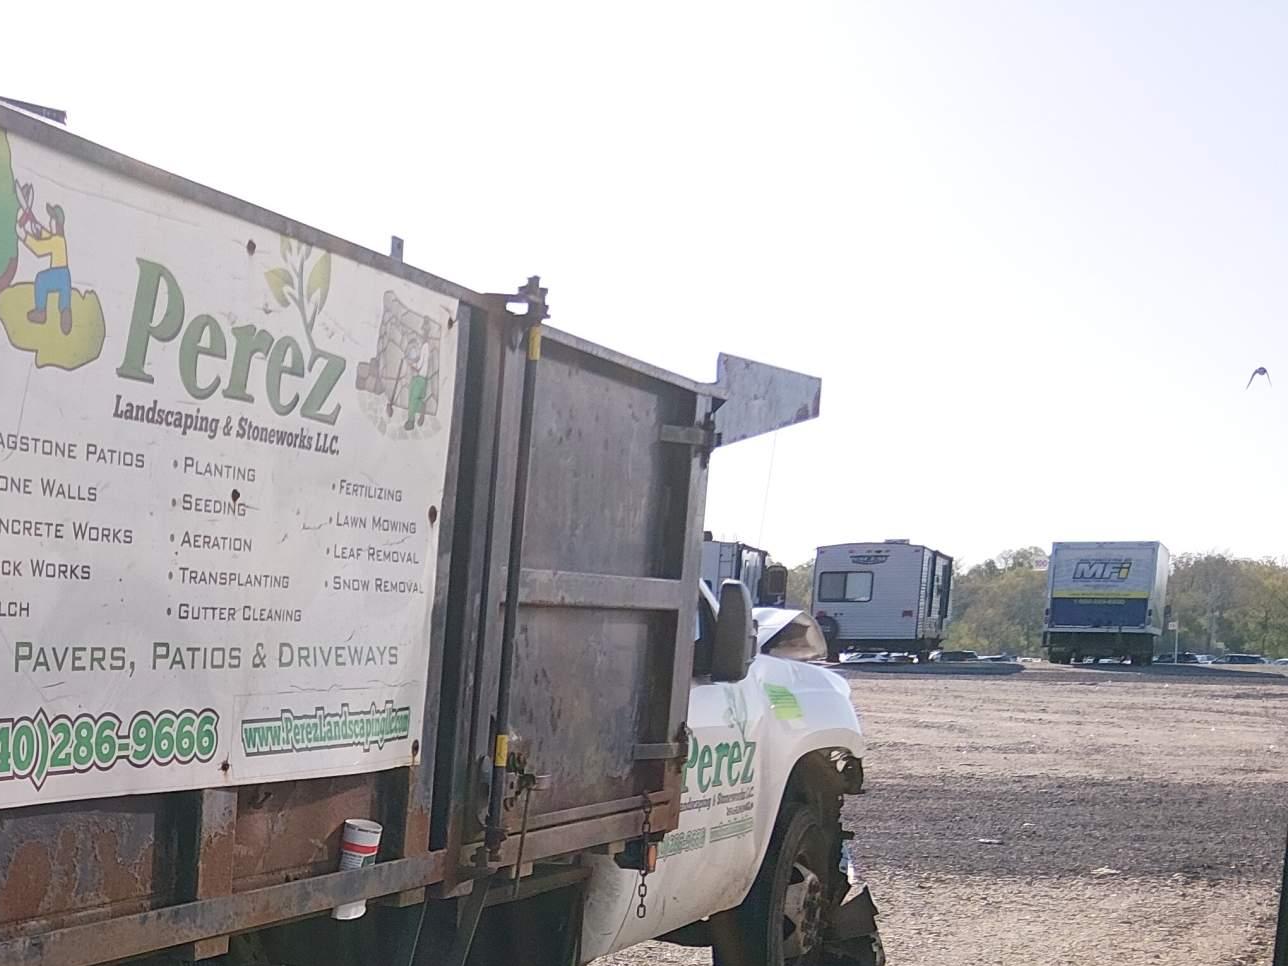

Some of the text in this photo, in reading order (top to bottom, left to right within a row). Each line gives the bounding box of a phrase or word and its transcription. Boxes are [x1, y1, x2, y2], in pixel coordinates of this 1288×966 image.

[115, 257, 347, 426] Perez
[112, 394, 341, 456] Landscaping & Stoneworks LLC.
[86, 443, 145, 469] PATIOS
[183, 456, 256, 482] PLANTING
[41, 477, 97, 502] WALLS
[339, 479, 402, 503] FERTILIZING
[182, 494, 246, 517] SEEDING
[72, 521, 133, 544] WORKS
[336, 512, 417, 535] LAWN MOWING
[180, 531, 252, 552] AERATION
[334, 544, 420, 565] LEAF REMOVAL
[30, 559, 91, 580] WORKS
[179, 567, 290, 589] TRANSPLANTING
[333, 576, 425, 595] SNOW REMOVAL
[178, 604, 302, 623] GUTTER CLEANING
[13, 641, 400, 677] PAVERS, PATIOS & DRIVEWAYS
[681, 736, 757, 793] Perez
